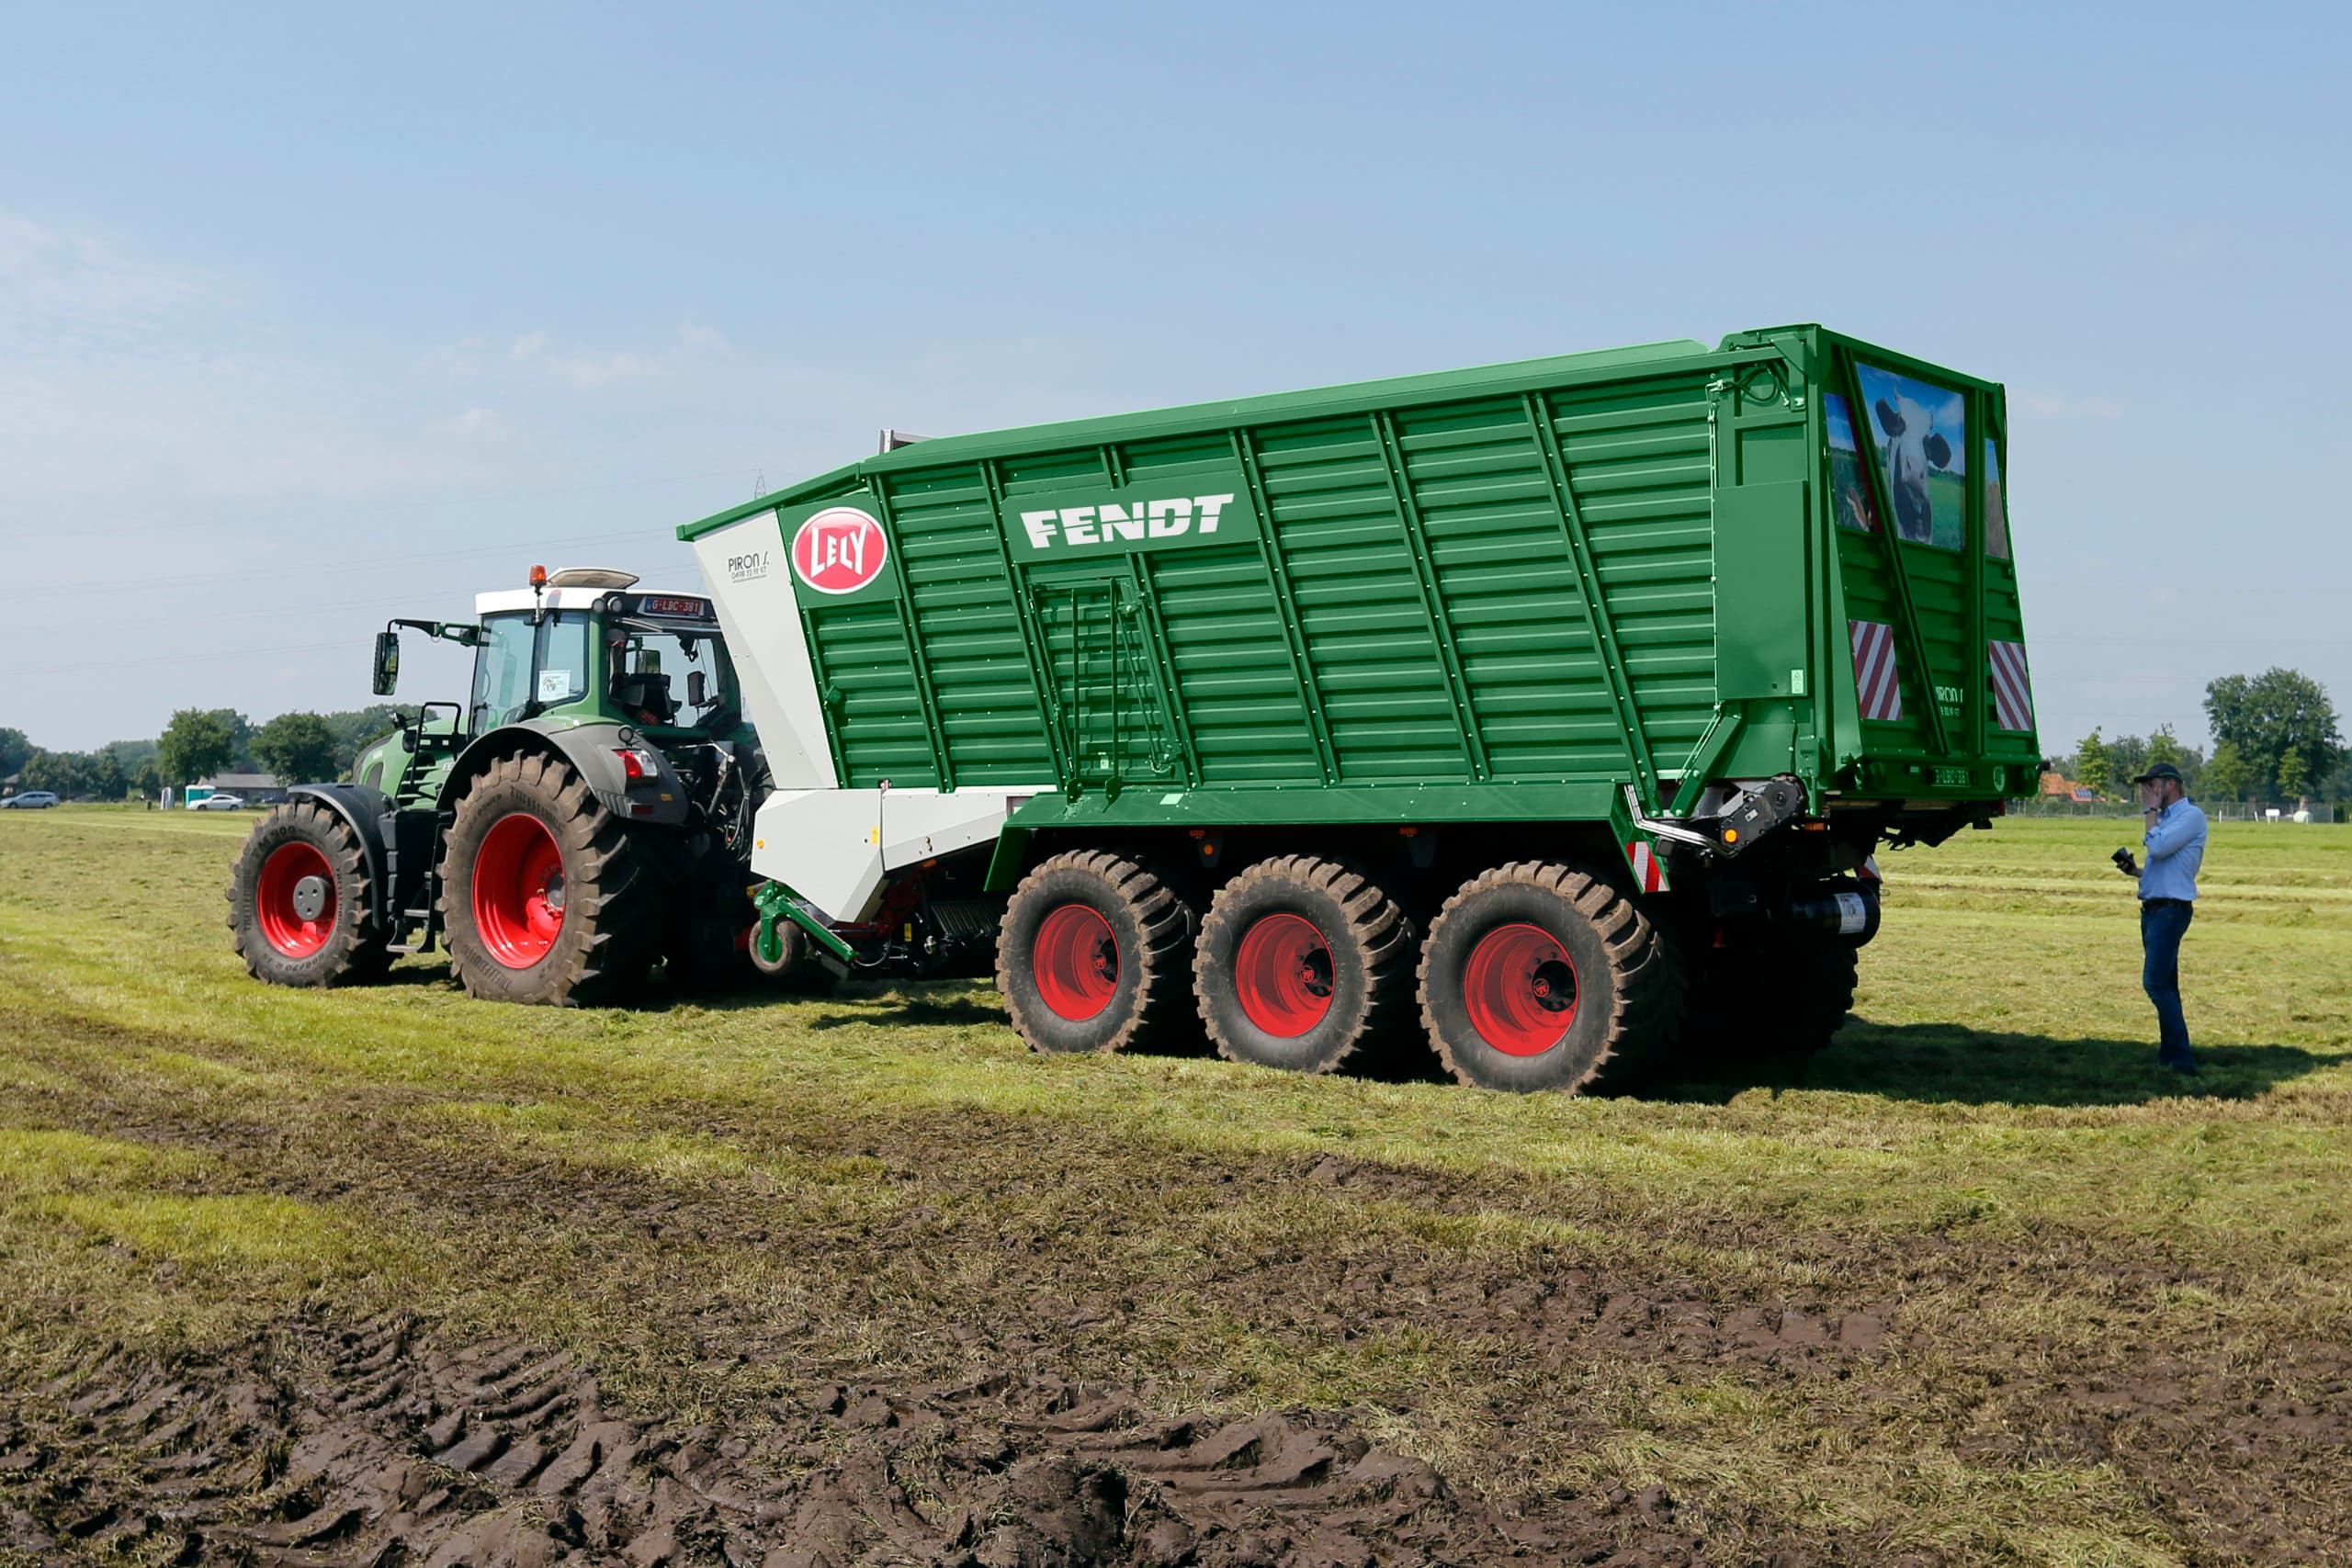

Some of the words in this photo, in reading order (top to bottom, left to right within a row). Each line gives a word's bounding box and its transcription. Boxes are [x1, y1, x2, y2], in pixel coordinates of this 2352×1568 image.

[1020, 493, 1235, 548] FENDT
[728, 553, 760, 572] PIRON
[810, 523, 867, 579] LELY
